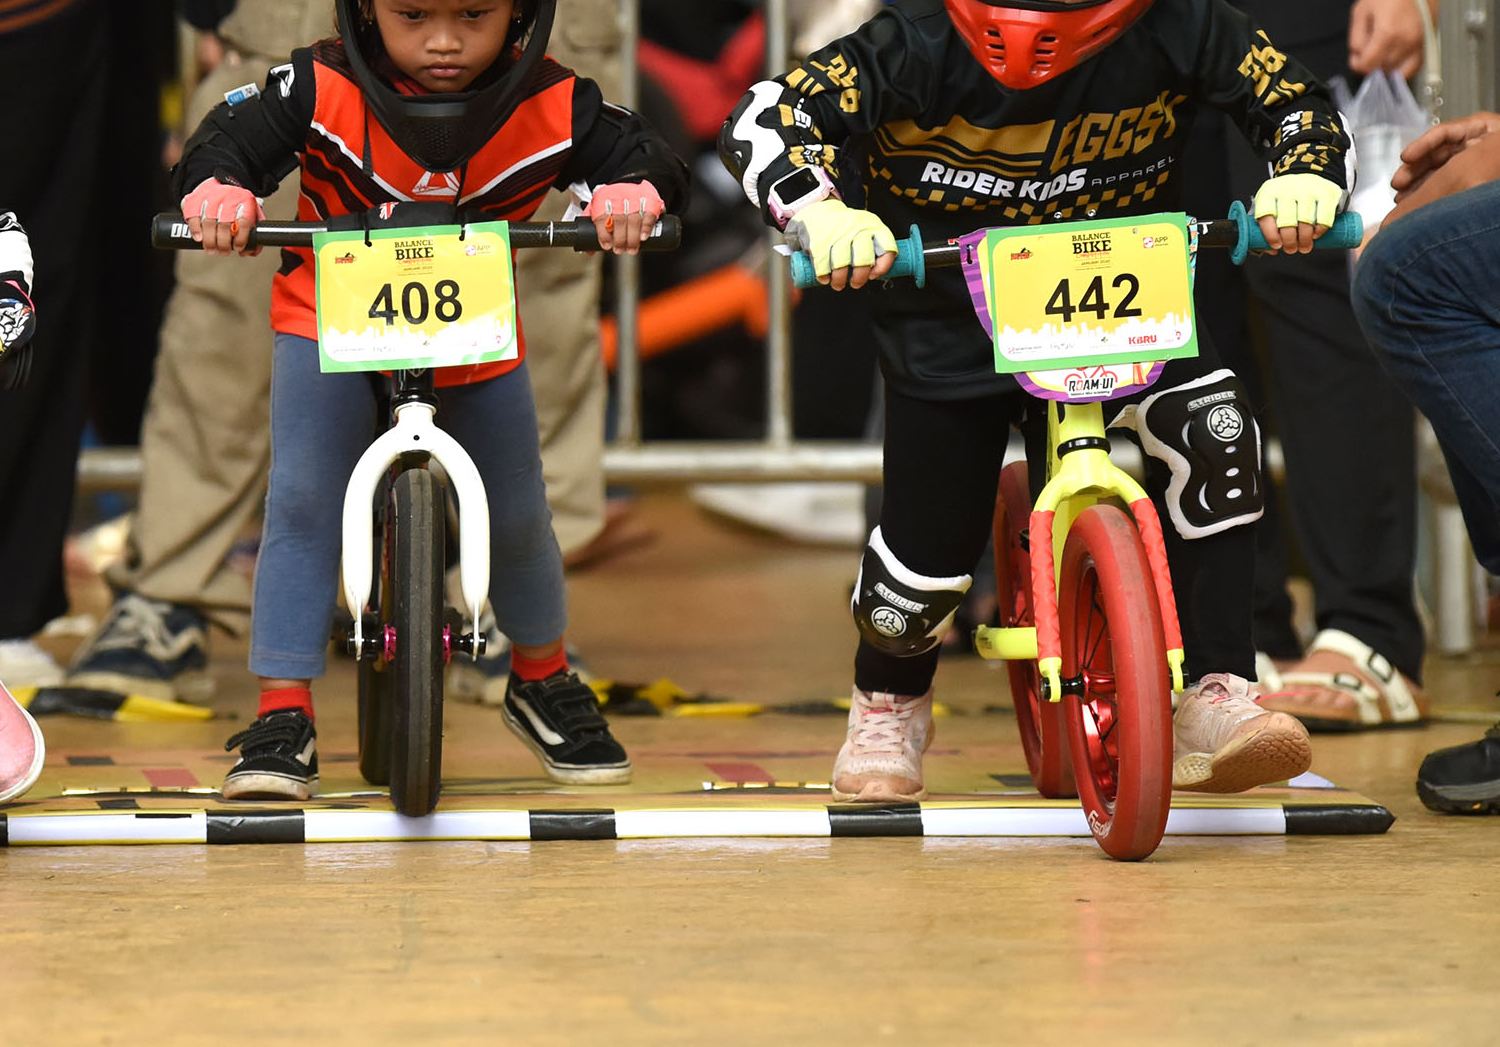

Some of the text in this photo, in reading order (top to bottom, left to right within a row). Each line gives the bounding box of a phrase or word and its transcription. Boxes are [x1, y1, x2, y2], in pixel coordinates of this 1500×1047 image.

[921, 155, 1176, 201] RIDER KIDS APPAREL
[395, 239, 434, 248] BALANCE
[1072, 232, 1111, 242] BALANCE
[1072, 240, 1112, 254] BIKE
[395, 247, 434, 260] BIKE
[368, 279, 463, 326] 408
[1045, 273, 1142, 323] 442
[1188, 391, 1237, 411] STRIDER
[874, 582, 925, 614] STRIDER
